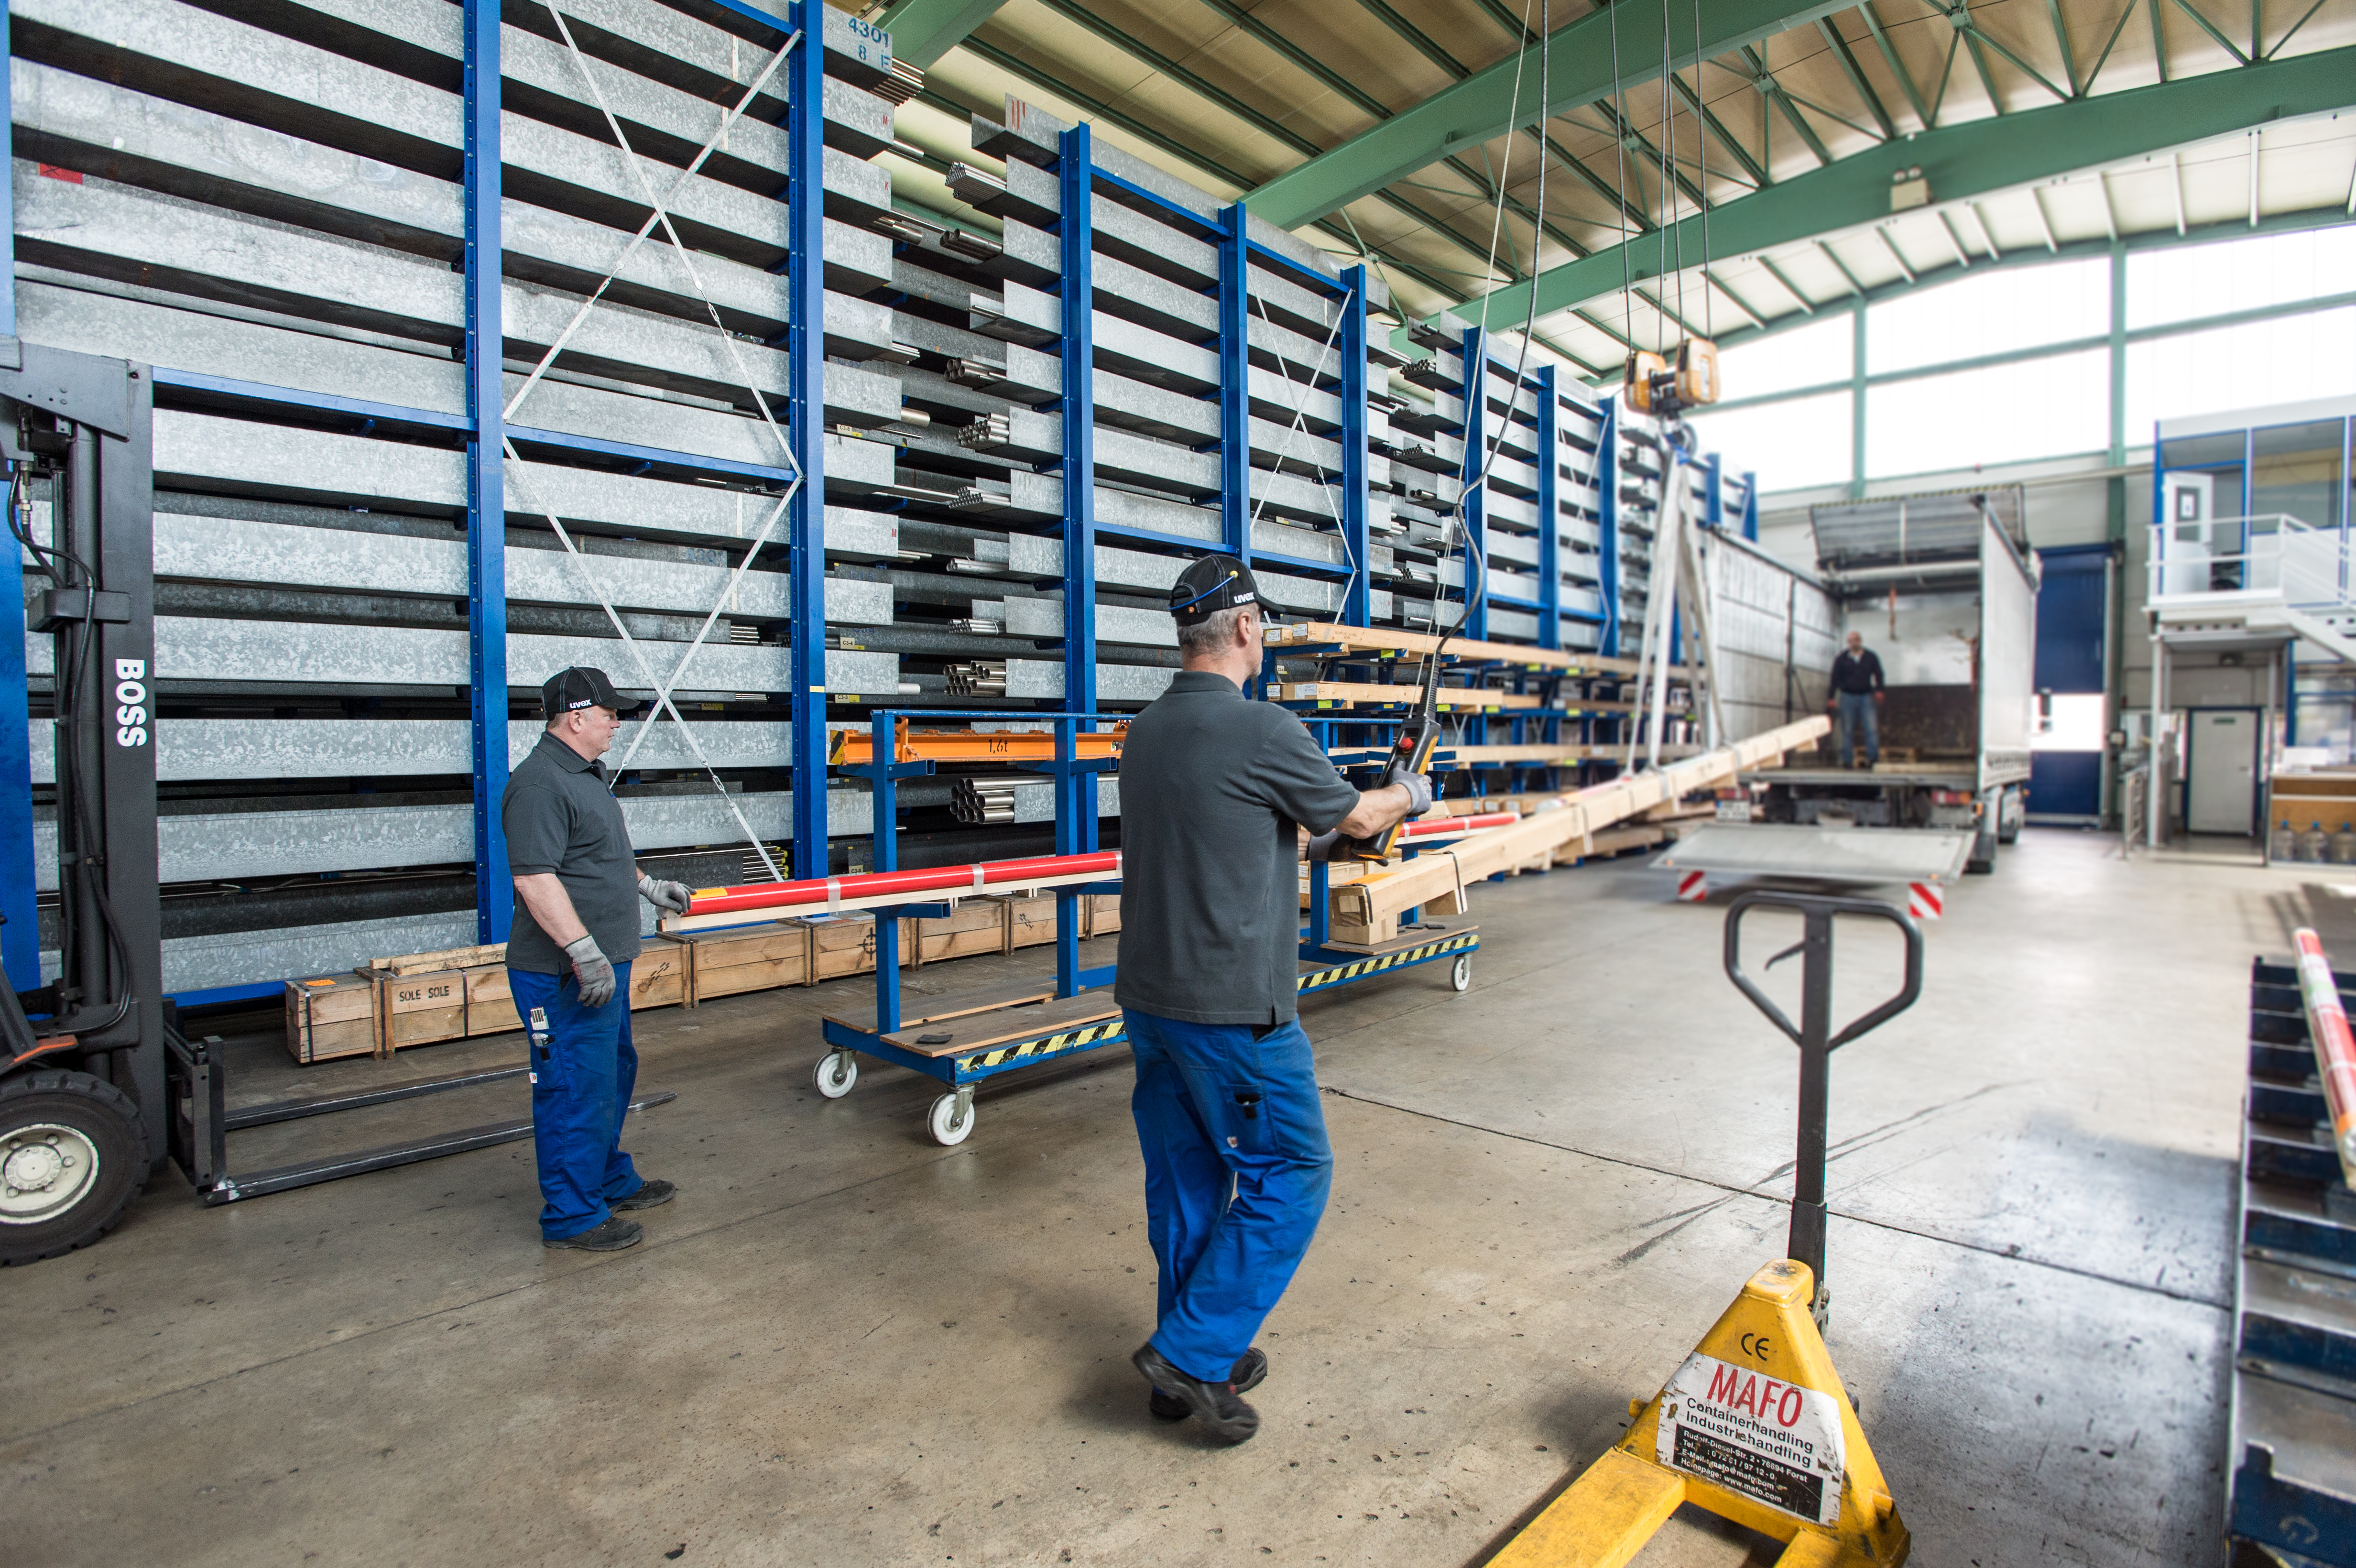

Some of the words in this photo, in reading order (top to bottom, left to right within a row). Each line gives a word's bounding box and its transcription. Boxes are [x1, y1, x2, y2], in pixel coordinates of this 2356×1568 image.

[848, 18, 888, 47] 4301
[859, 44, 866, 61] 8
[881, 54, 891, 72] E
[892, 528, 896, 537] M
[1234, 592, 1254, 603] uvex
[116, 659, 147, 747] BOSS
[569, 699, 592, 708] uvex
[399, 990, 421, 1002] SOLE
[428, 986, 449, 998] SOLE
[1707, 1364, 1803, 1427] MAFO
[1686, 1411, 1811, 1468] Industriehandling
[1687, 1397, 1813, 1454] Containerhandling
[1683, 1438, 1695, 1449] Tel.
[1744, 1462, 1754, 1471] 97
[1756, 1467, 1765, 1477] 12
[1769, 1472, 1775, 1480] 0
[1750, 1455, 1755, 1463] 2
[1762, 1459, 1784, 1474] 76694
[1786, 1468, 1808, 1482] Forst
[1724, 1475, 1782, 1503] www.mafo.com
